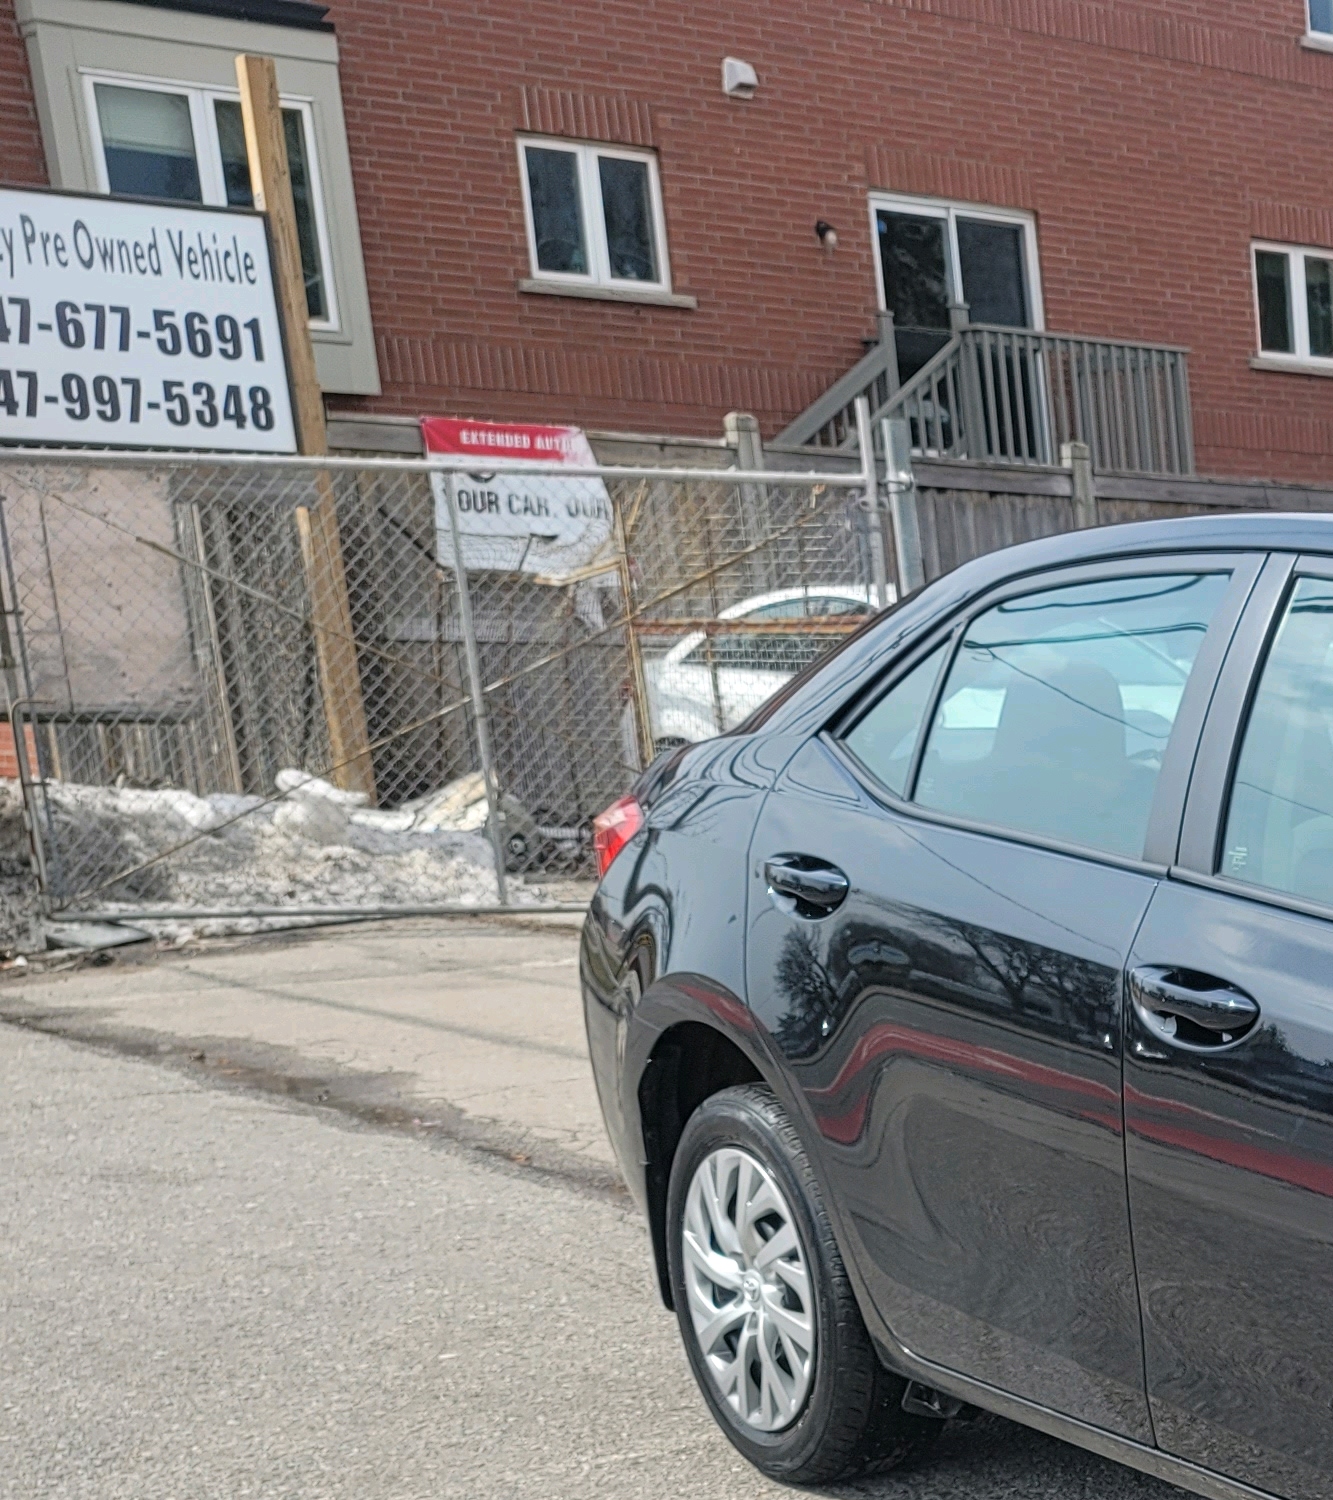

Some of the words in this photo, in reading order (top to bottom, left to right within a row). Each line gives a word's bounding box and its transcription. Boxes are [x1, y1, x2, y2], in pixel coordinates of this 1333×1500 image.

[19, 213, 69, 268] Pre
[73, 219, 162, 278] Owned
[166, 228, 258, 285] Vehicle
[459, 429, 531, 450] EXTENDED
[443, 487, 499, 514] OUR
